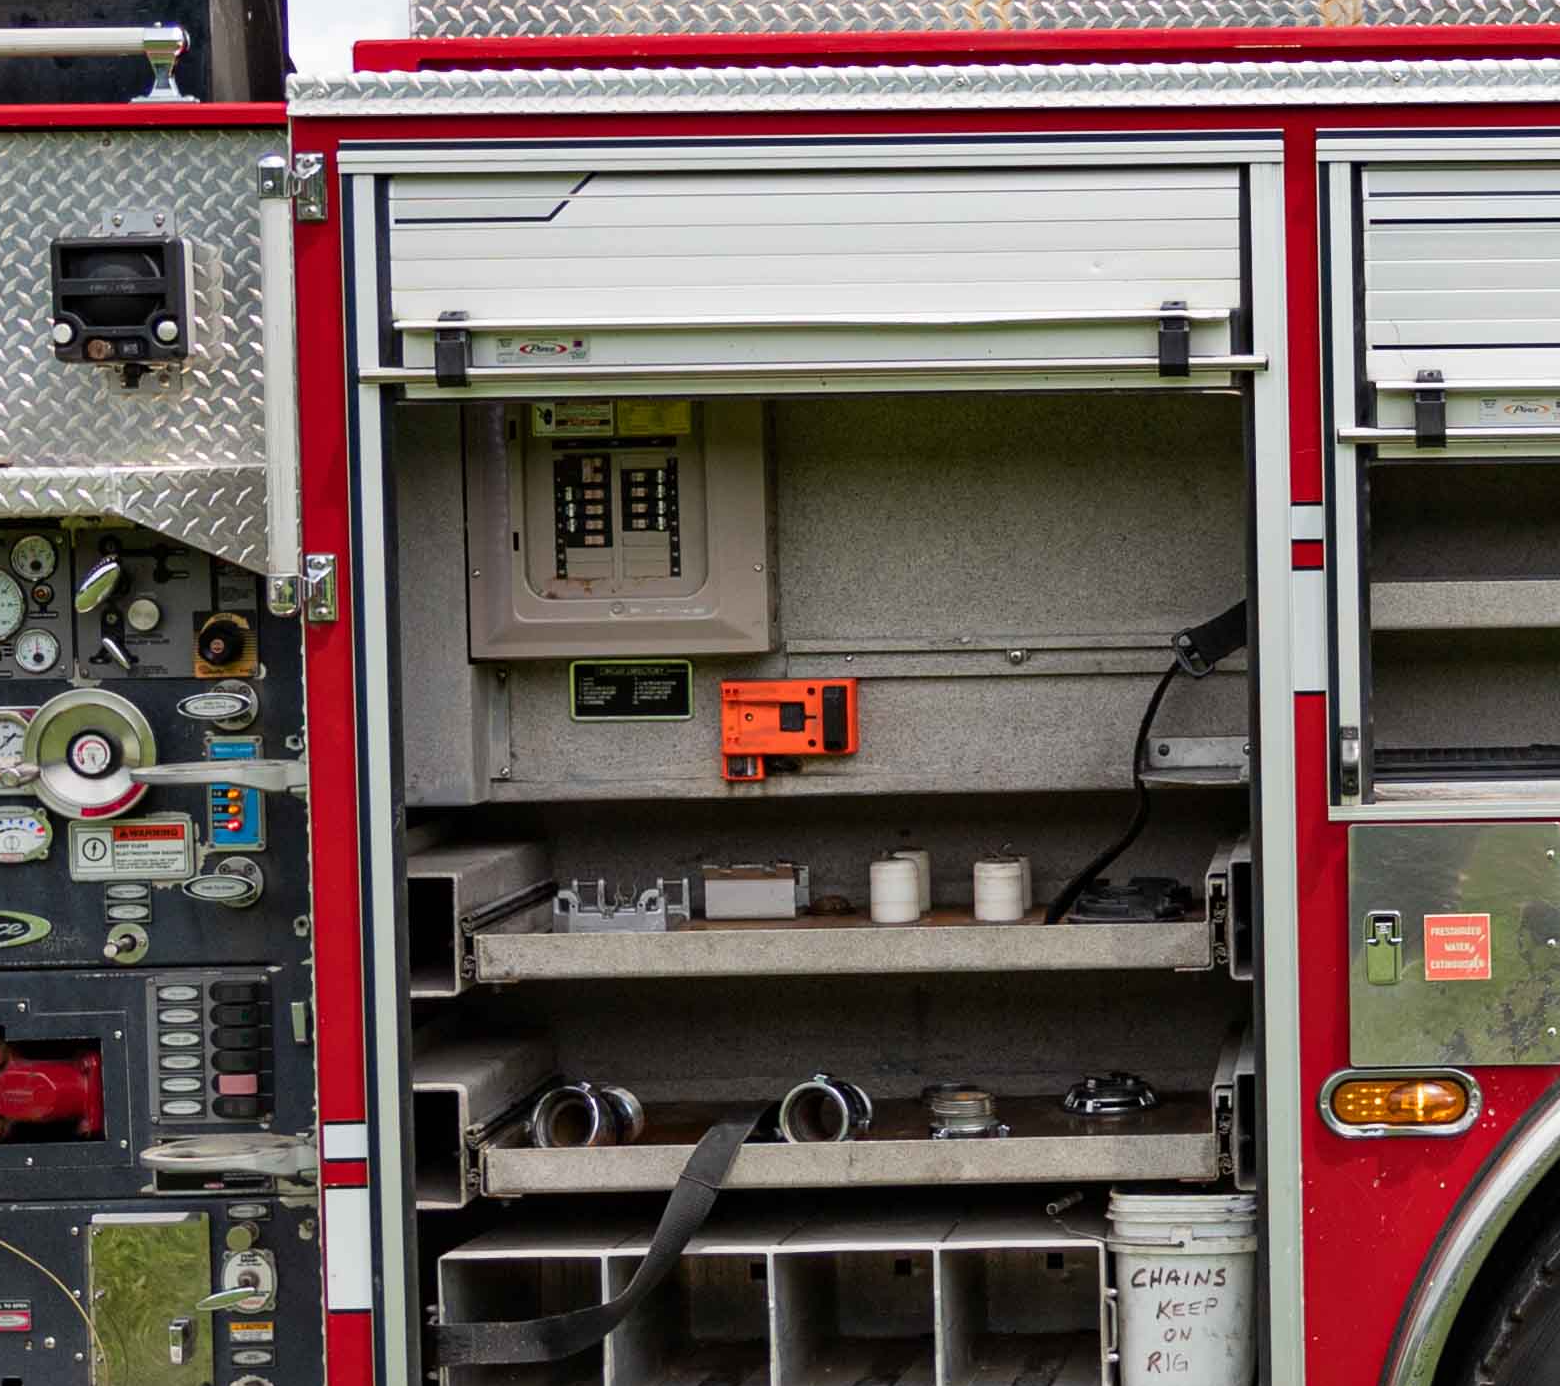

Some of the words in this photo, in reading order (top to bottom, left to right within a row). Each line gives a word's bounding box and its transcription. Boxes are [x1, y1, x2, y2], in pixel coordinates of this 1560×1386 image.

[129, 828, 178, 837] WARNING
[1131, 1266, 1227, 1289] CHAINS
[1155, 1297, 1218, 1320] KEEP
[1163, 1326, 1192, 1343] ON
[1147, 1350, 1189, 1374] RIG
